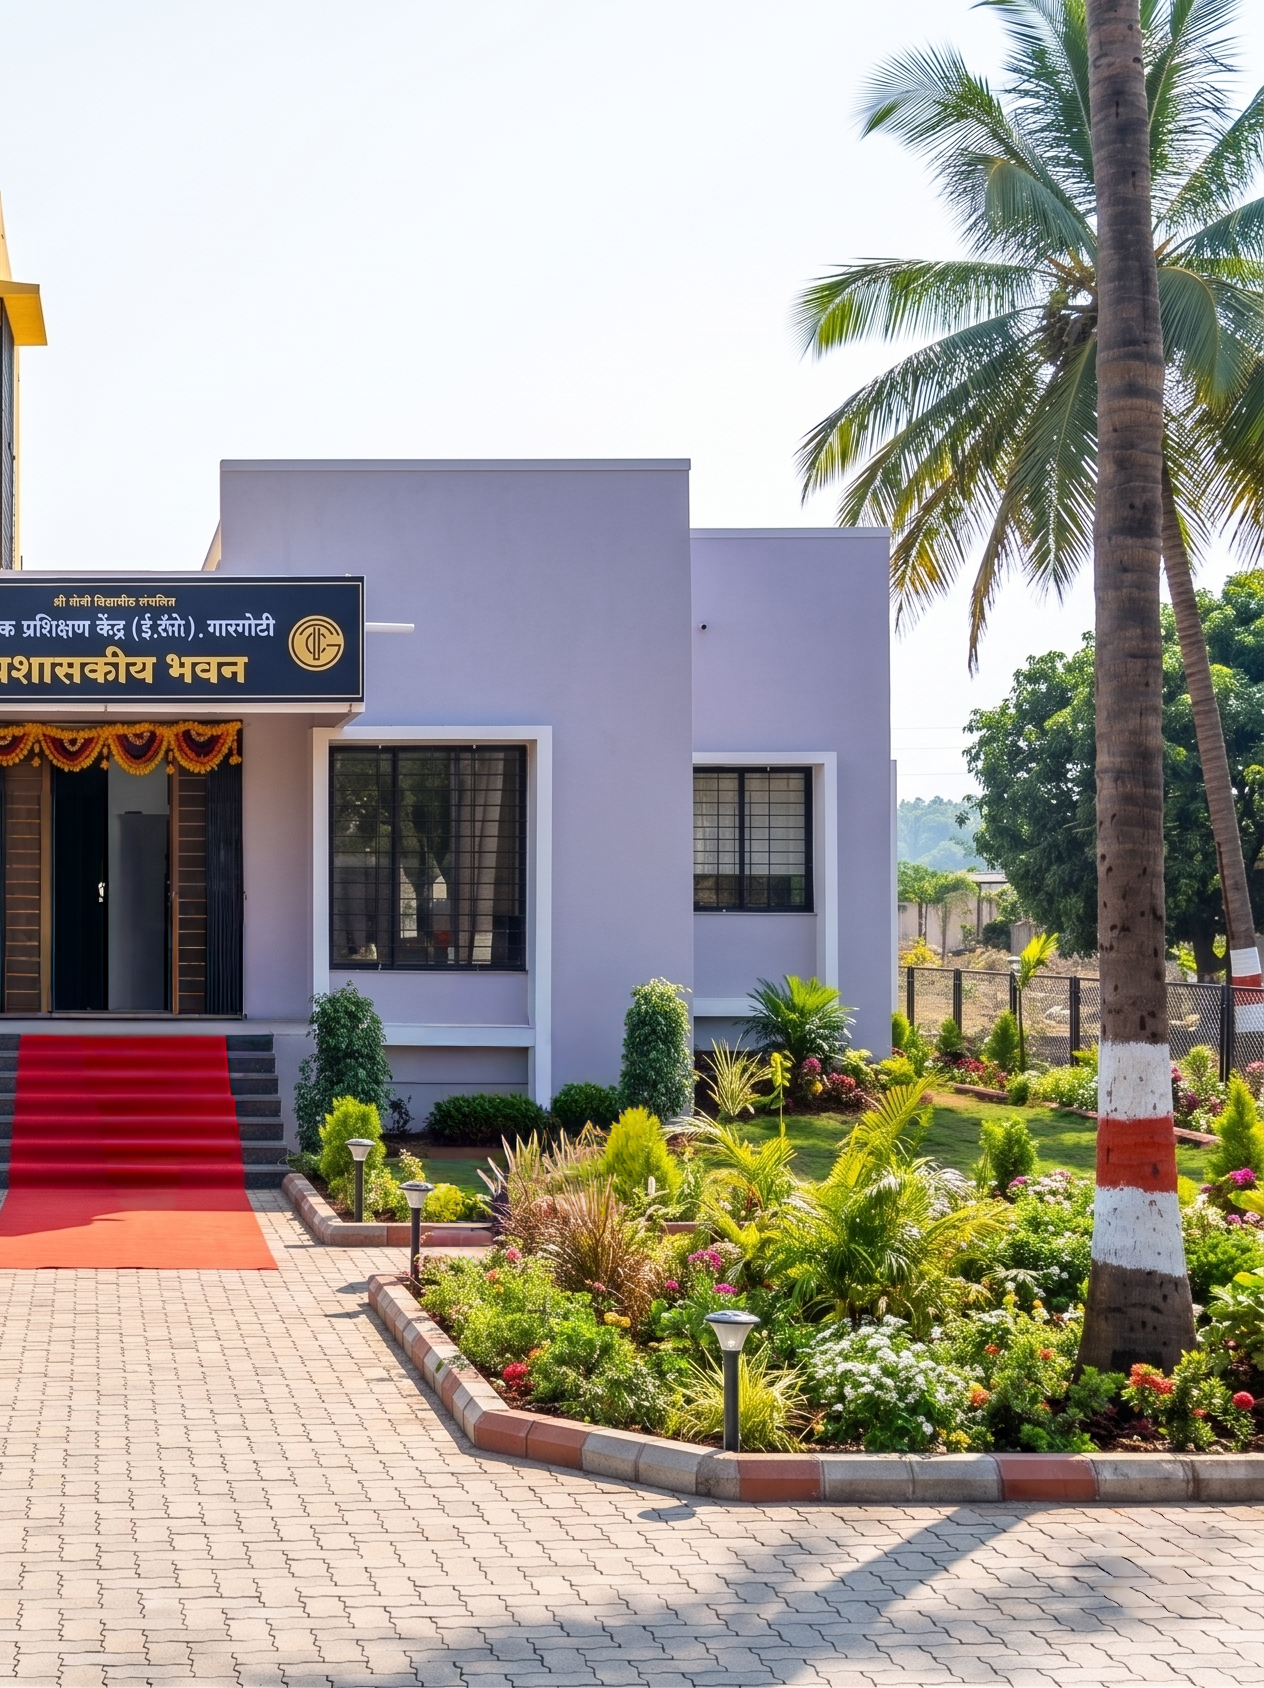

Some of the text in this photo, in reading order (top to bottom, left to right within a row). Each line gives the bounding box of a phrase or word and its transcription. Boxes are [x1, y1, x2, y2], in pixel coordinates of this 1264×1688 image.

[21, 613, 91, 639] प्रशिक्षण
[95, 613, 126, 640] केंद्र
[207, 612, 276, 638] गारगोटी
[166, 653, 249, 684] भवन
